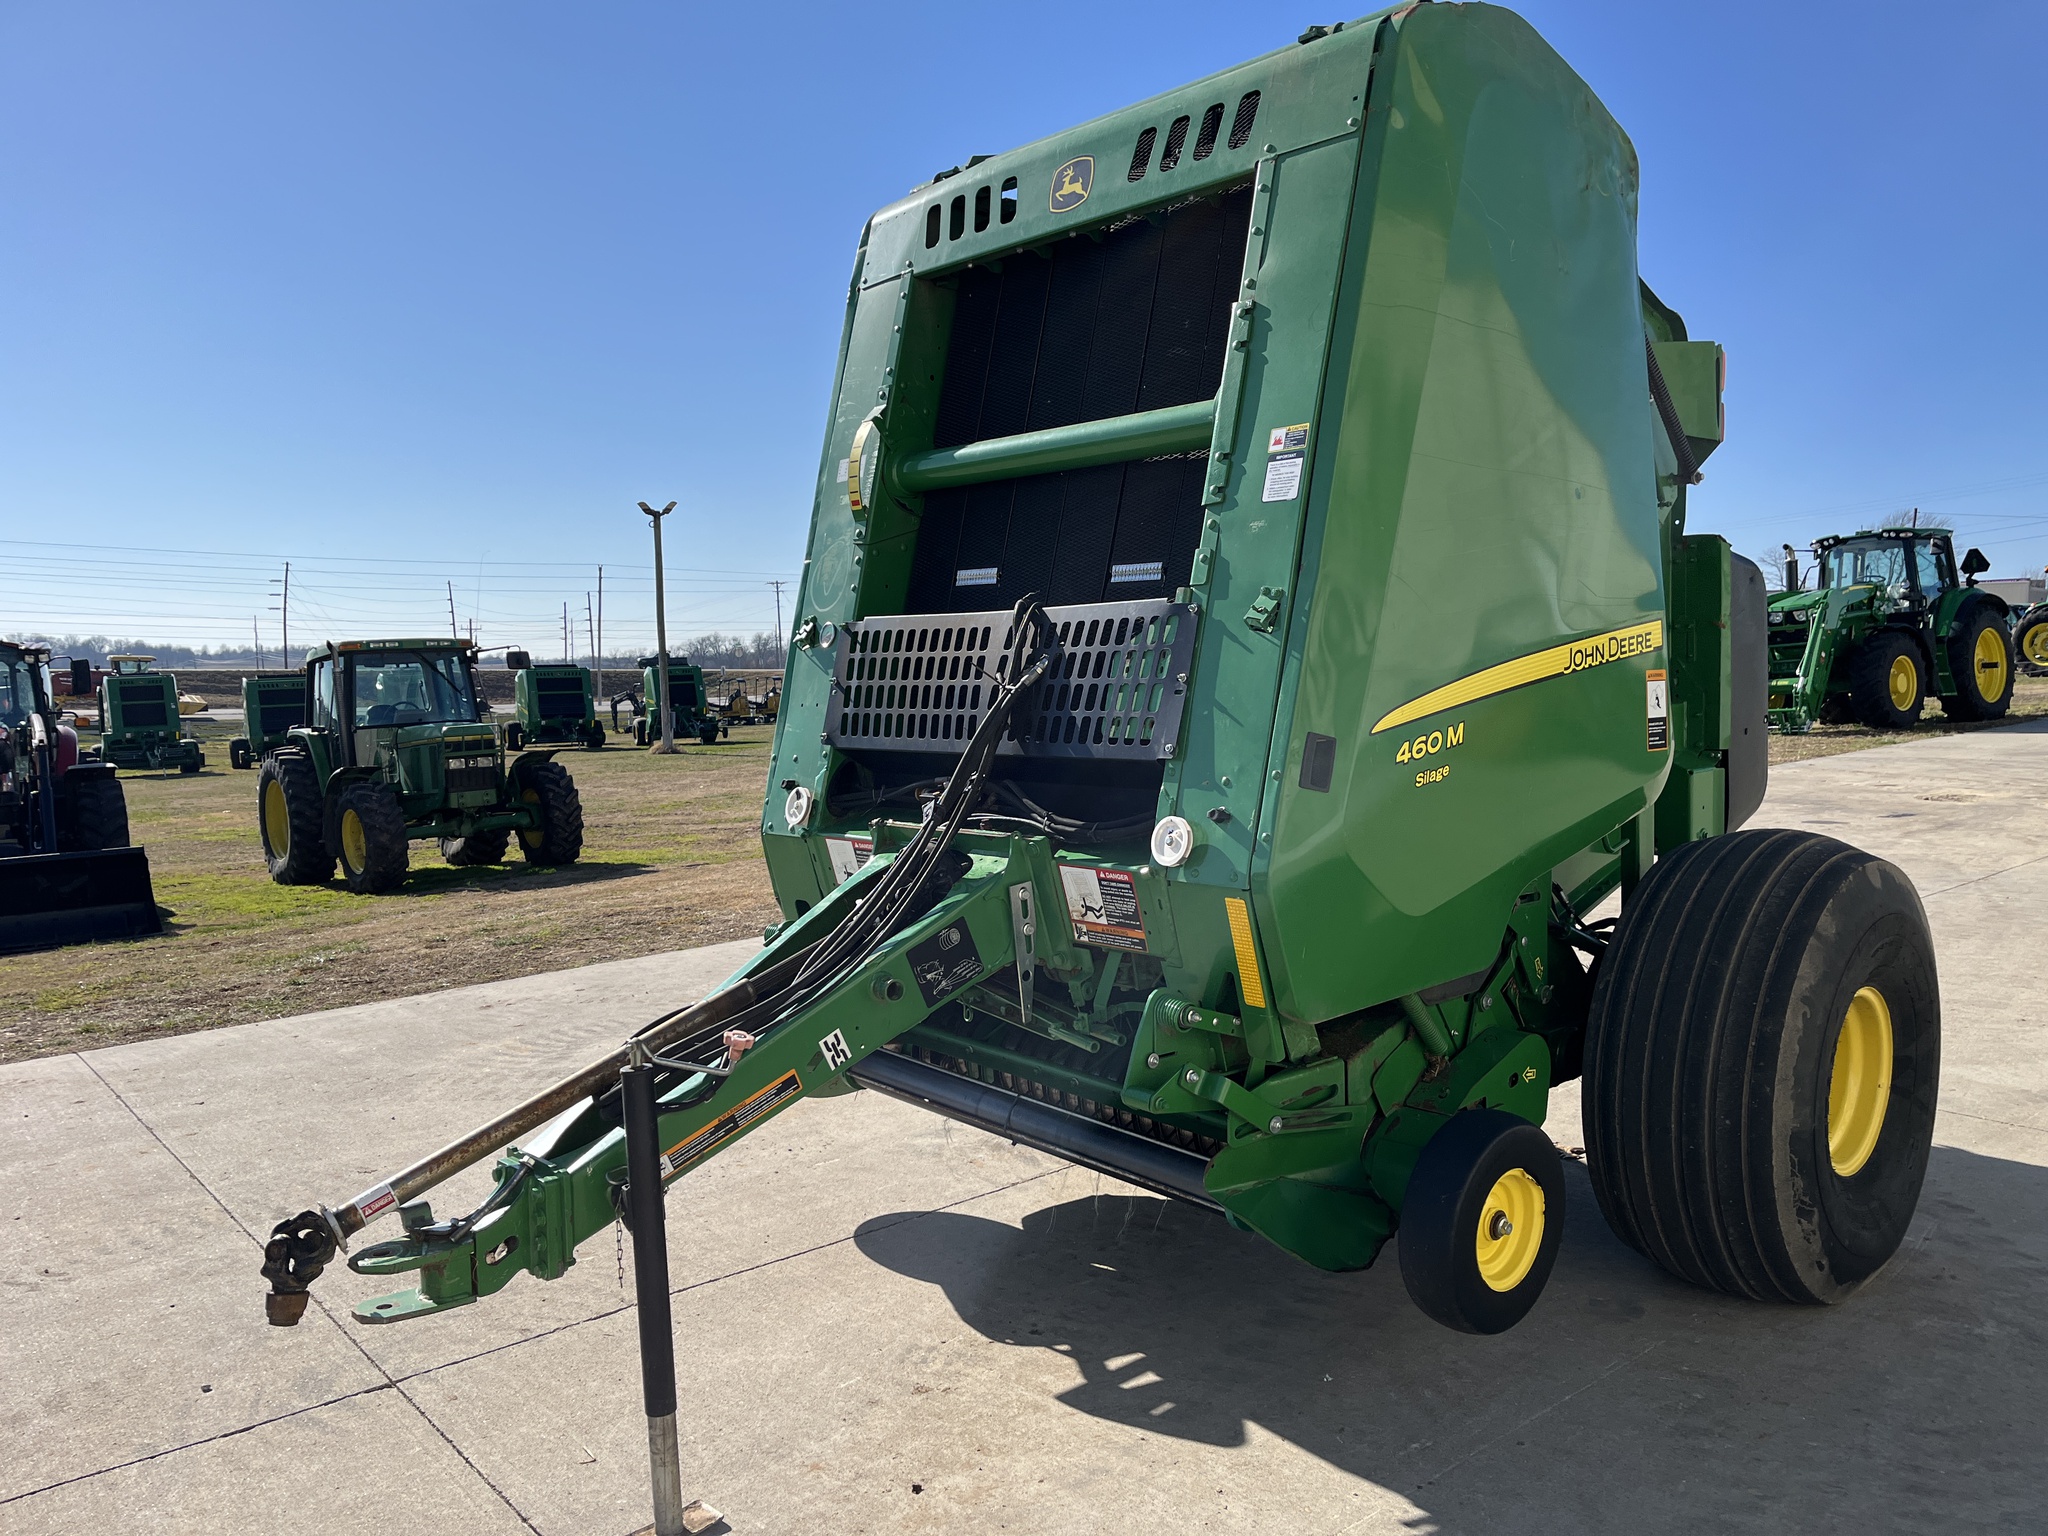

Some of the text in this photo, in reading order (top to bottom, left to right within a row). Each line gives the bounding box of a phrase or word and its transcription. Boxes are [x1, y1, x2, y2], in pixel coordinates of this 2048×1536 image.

[1563, 631, 1652, 671] JOHN DEERE
[1395, 720, 1465, 765] 460 M
[1415, 764, 1450, 788] Silage
[1105, 872, 1129, 881] DANGER
[1105, 927, 1129, 936] WARNING
[721, 1100, 747, 1120] WARNING
[370, 1195, 392, 1211] DANGER
